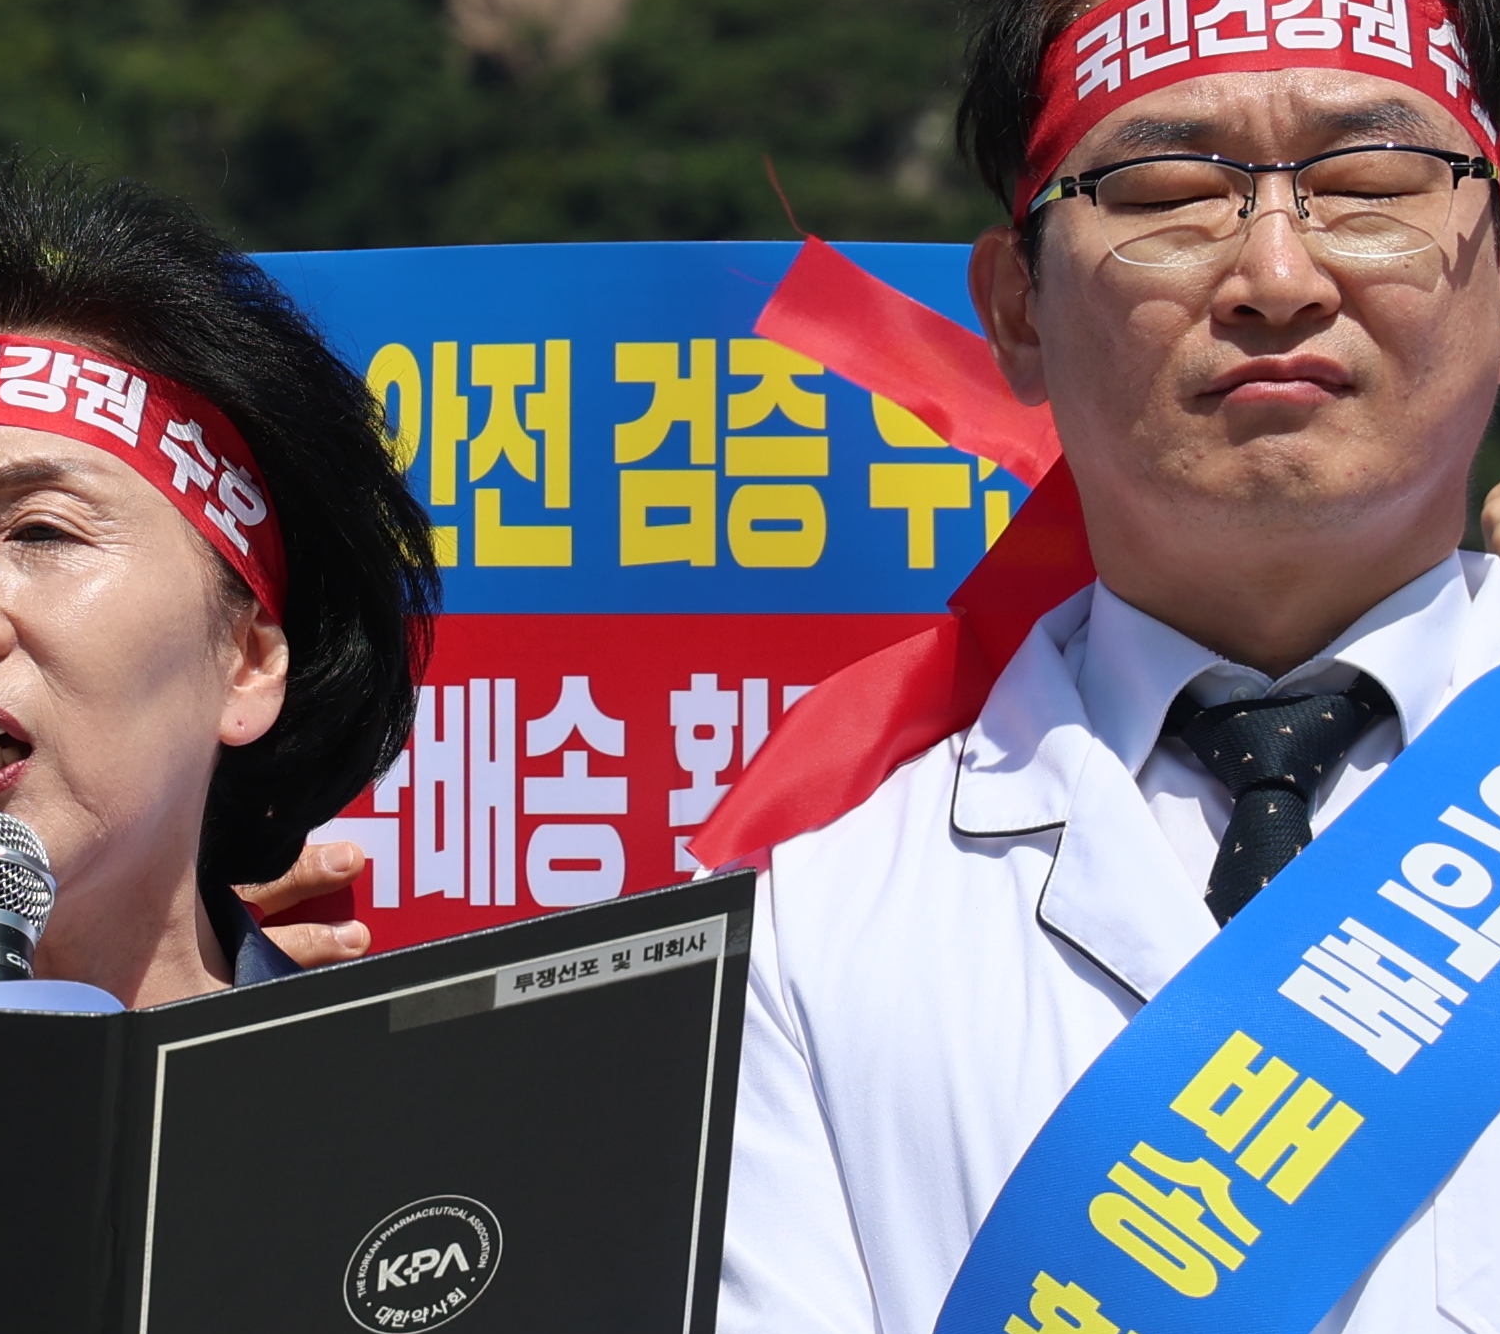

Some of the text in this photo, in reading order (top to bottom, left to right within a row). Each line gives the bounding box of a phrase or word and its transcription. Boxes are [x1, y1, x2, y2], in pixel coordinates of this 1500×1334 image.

[158, 418, 268, 557] 수호
[364, 338, 1011, 569] 안전 검증 우
[513, 932, 707, 994] 투쟁선포 및 대회사
[1087, 1028, 1365, 1299] 배송
[358, 1240, 383, 1278] KOREAN
[379, 1205, 469, 1242] PHARMACEUTICAL
[467, 1214, 491, 1269] ASSOCIATION
[374, 1286, 467, 1328] 대한약사회
